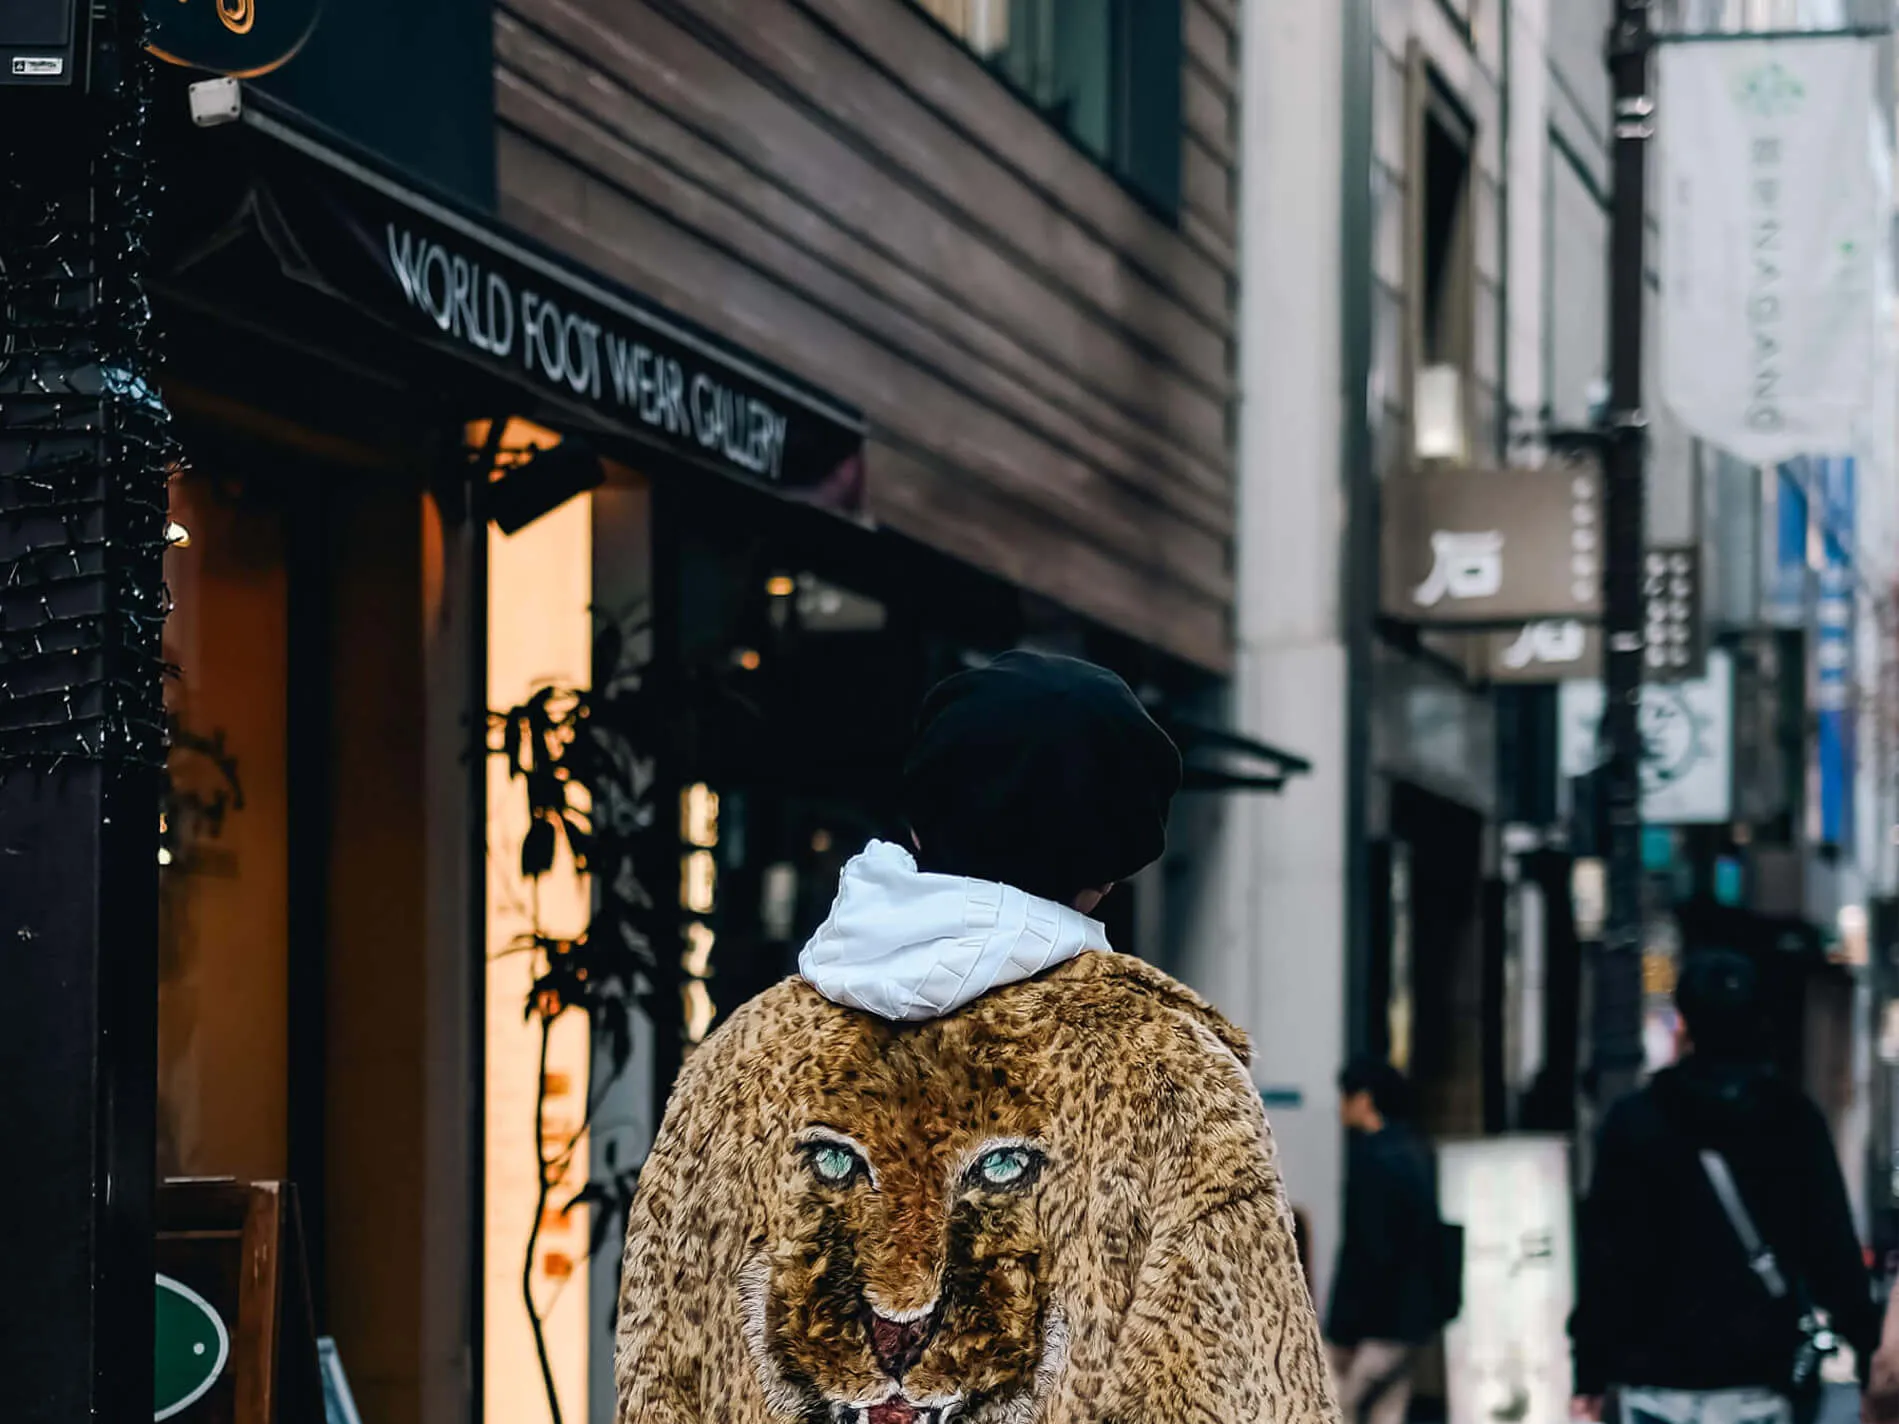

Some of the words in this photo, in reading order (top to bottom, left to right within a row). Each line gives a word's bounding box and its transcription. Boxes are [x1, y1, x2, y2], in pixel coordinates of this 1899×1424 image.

[387, 222, 514, 357] WORLD
[521, 289, 602, 400] FOOT
[605, 331, 692, 437] WEAR
[690, 372, 788, 480] GALLERY
